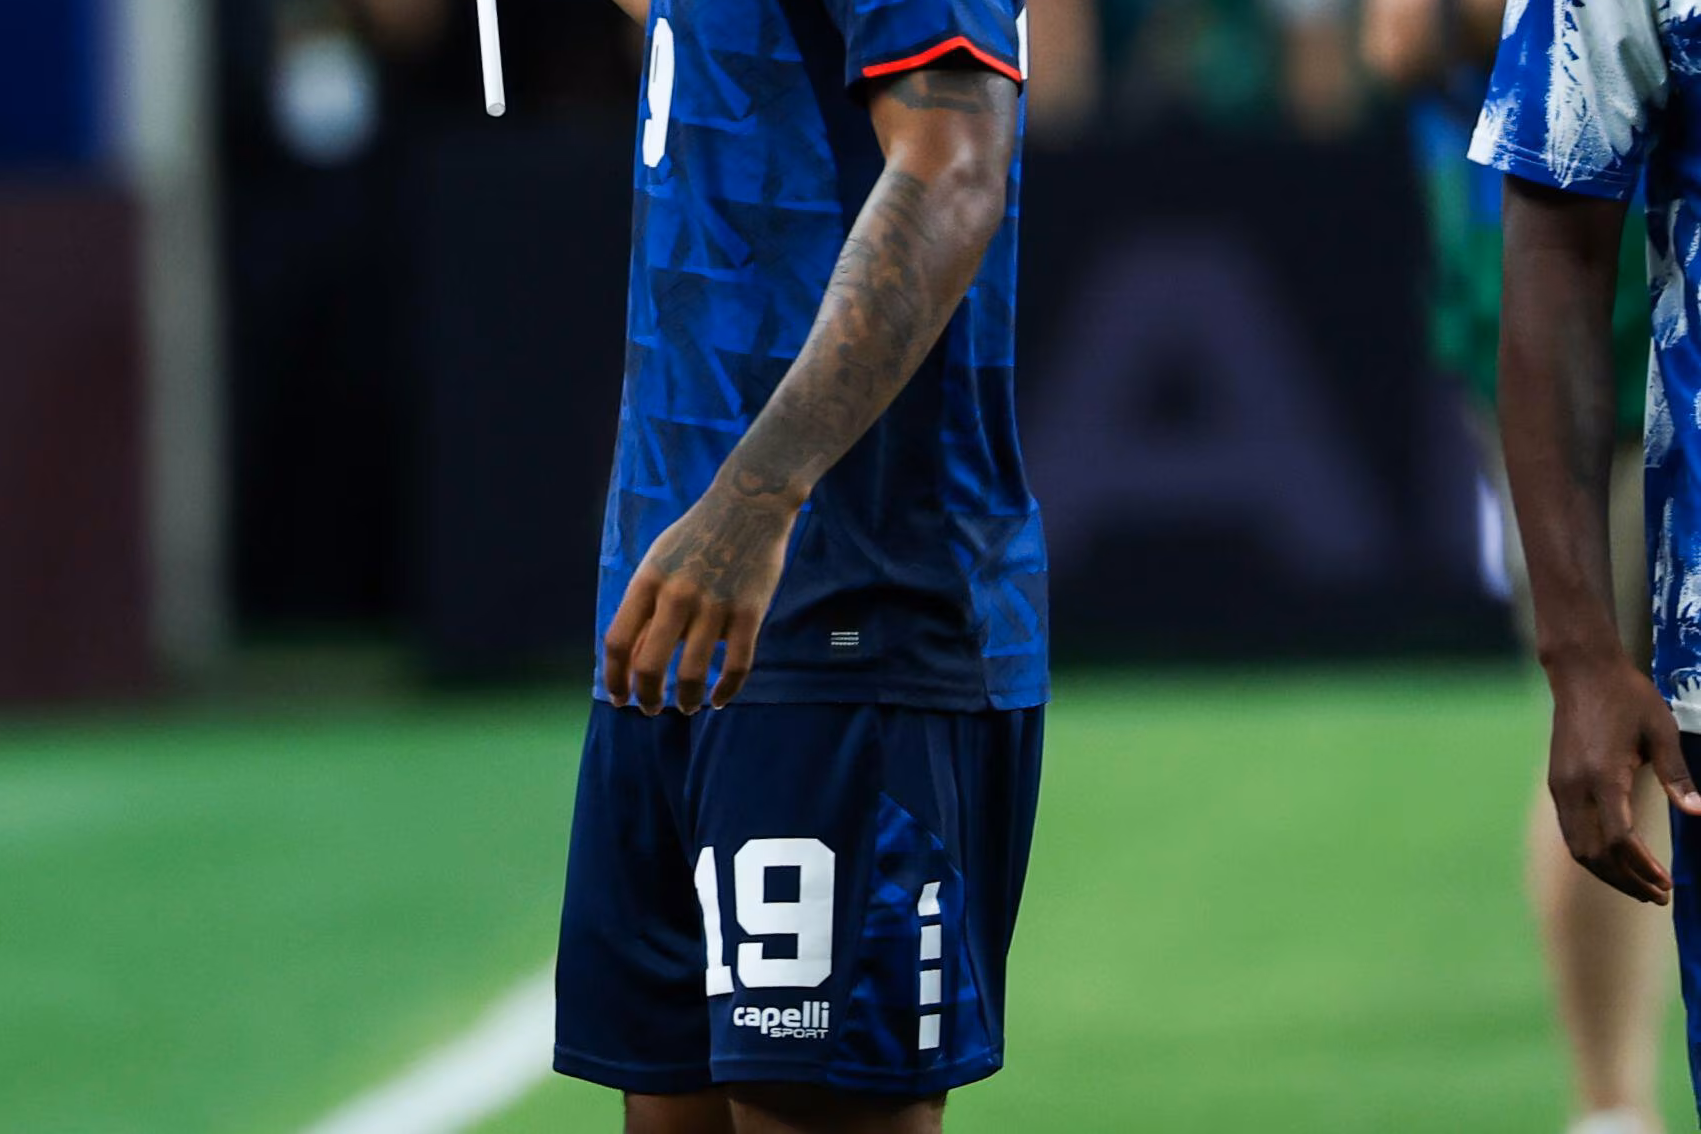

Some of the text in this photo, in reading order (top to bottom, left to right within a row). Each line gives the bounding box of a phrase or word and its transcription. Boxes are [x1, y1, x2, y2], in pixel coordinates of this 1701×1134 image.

[694, 837, 836, 996] 19
[733, 1000, 830, 1034] capelli
[769, 1027, 829, 1039] SPORT
